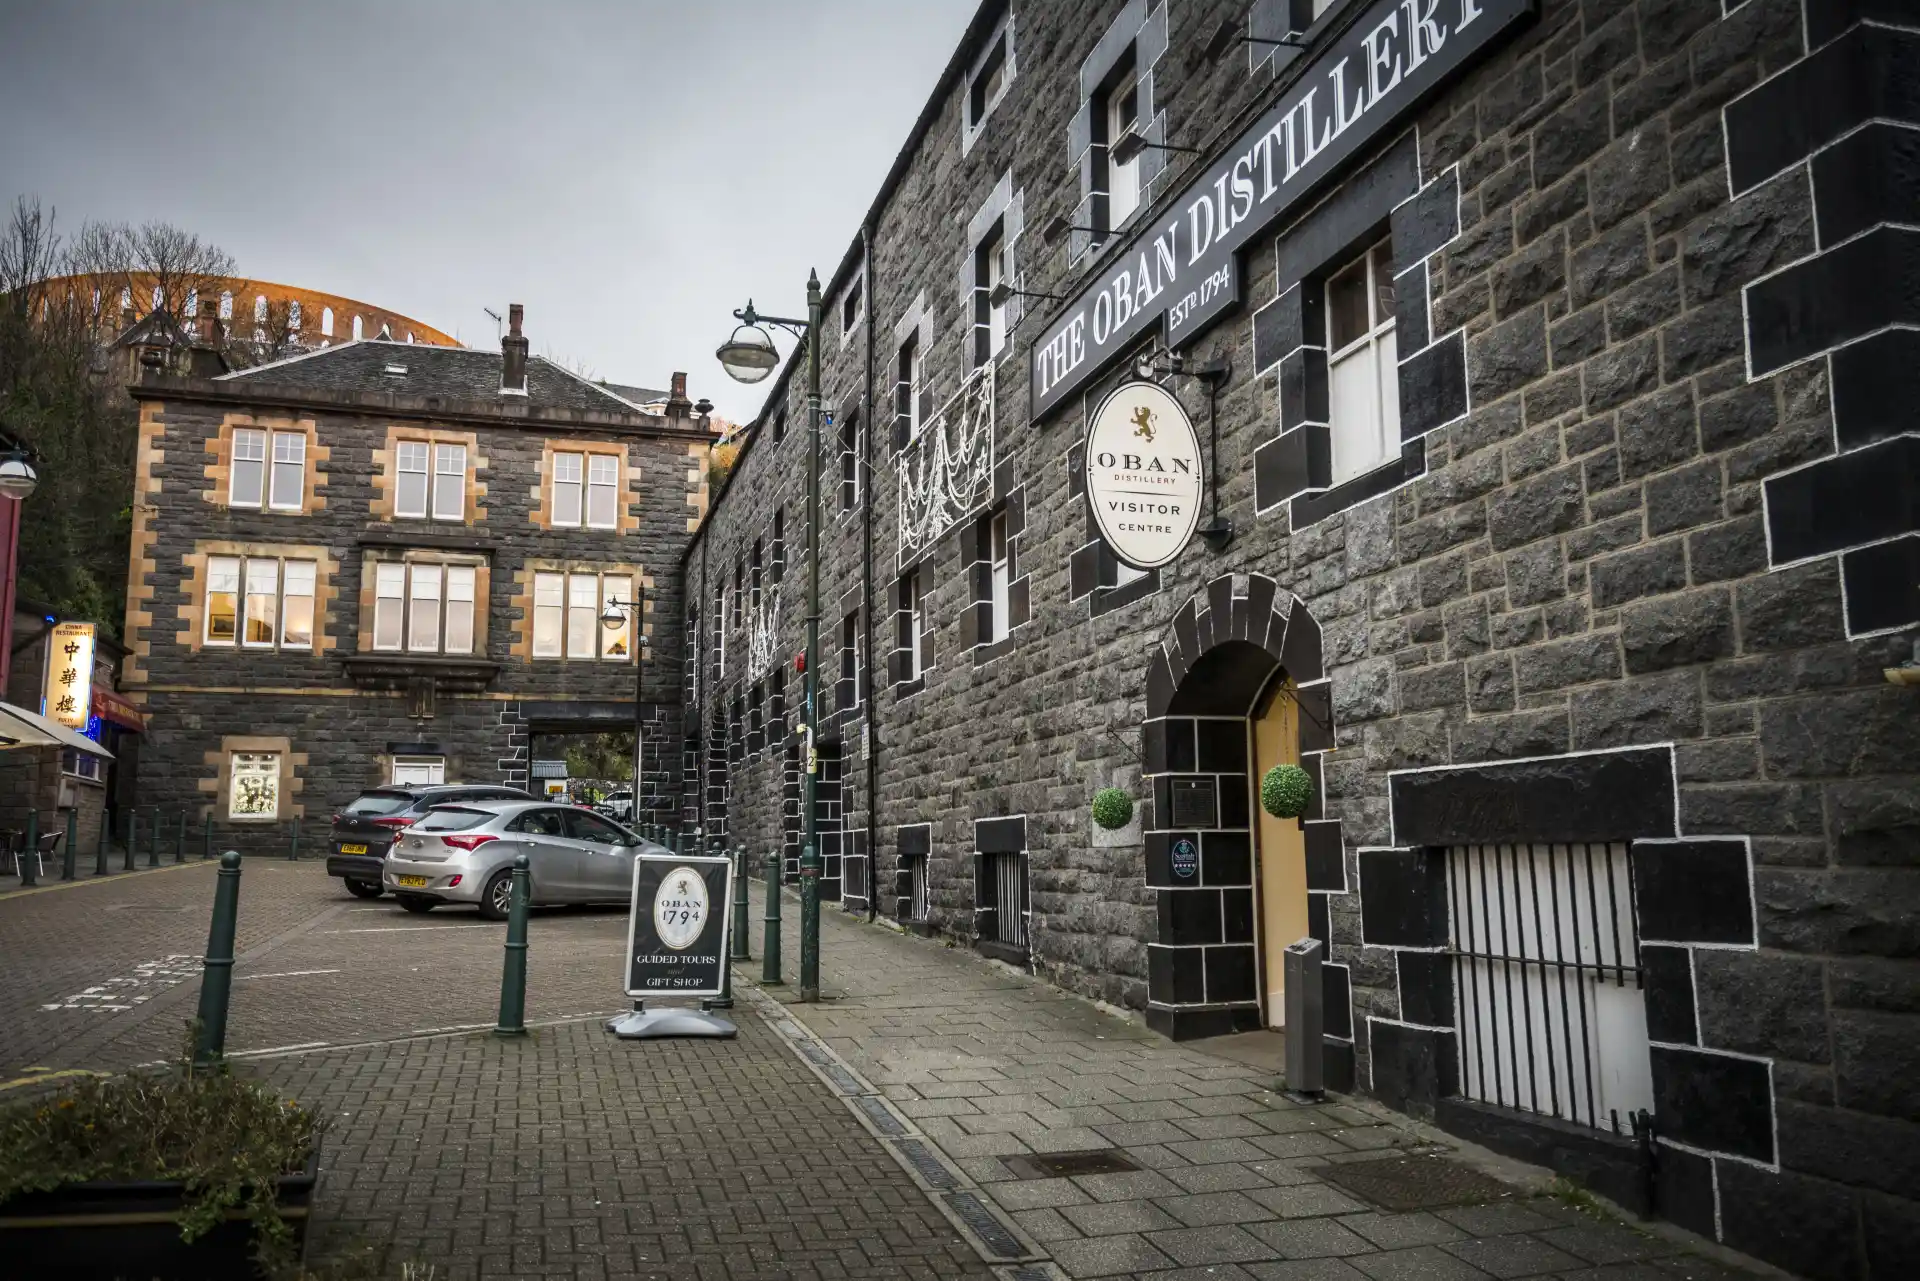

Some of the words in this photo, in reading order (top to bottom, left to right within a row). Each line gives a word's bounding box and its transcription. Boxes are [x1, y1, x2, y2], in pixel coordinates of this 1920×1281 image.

[1200, 263, 1230, 307] 1794
[1038, 311, 1085, 398] THE
[1093, 221, 1178, 345] OBAN
[1097, 452, 1192, 475] OBAN
[1114, 474, 1176, 485] DISTILLERY
[1108, 501, 1180, 516] VISITOR
[1118, 523, 1172, 534] CENTRE
[55, 640, 80, 713] 中華樓
[661, 899, 702, 908] OBAN
[662, 910, 700, 925] 1794
[636, 955, 678, 964] GUIDED
[680, 955, 716, 964] TOURS
[646, 977, 671, 987] GIFT
[673, 978, 703, 987] SHOP
